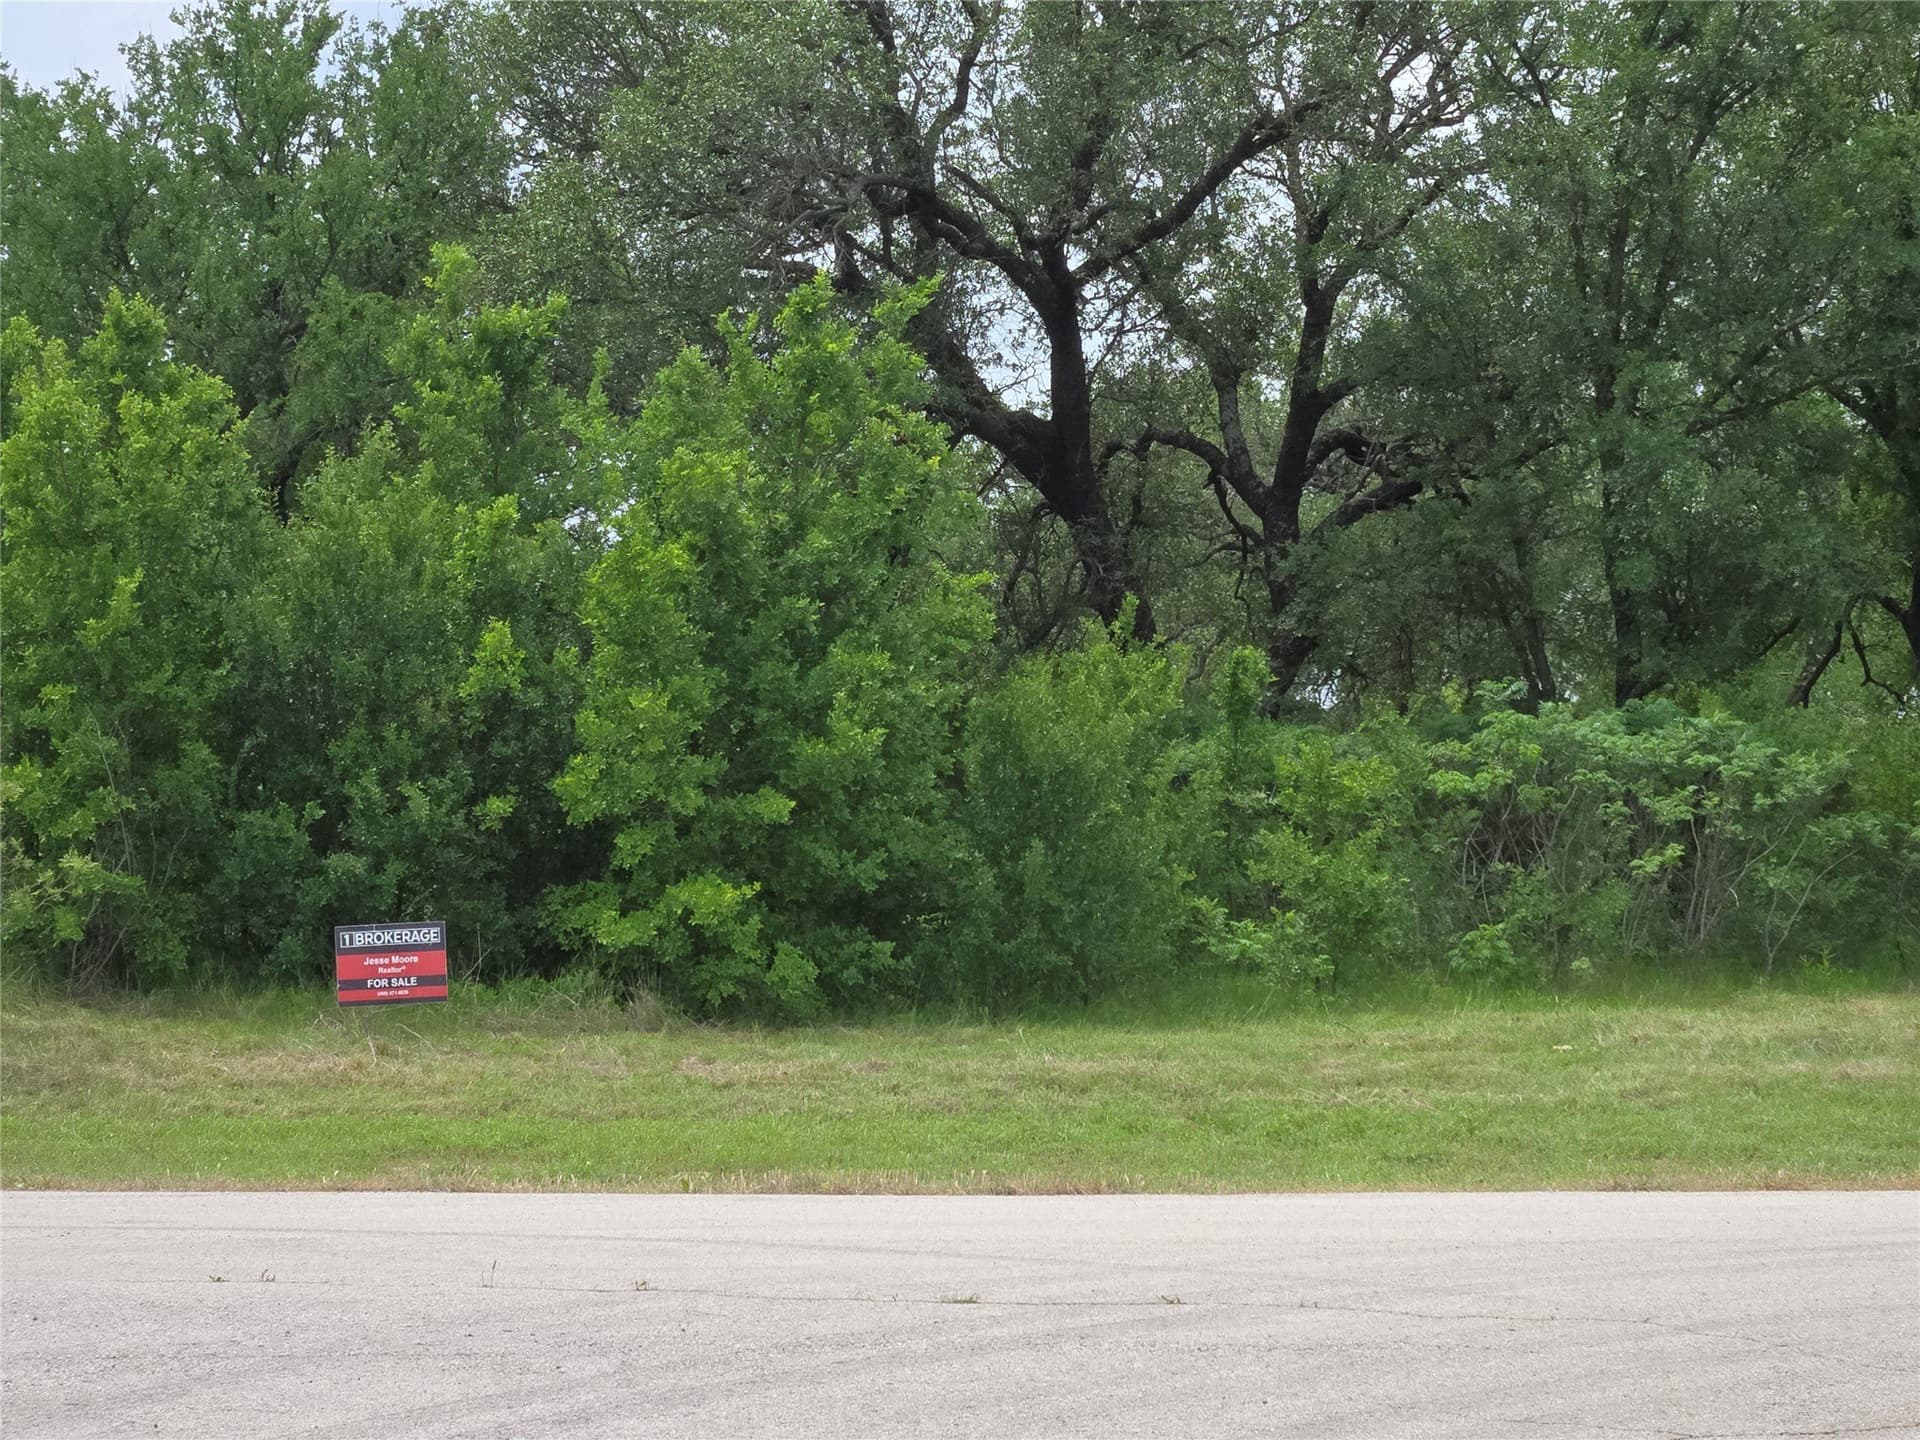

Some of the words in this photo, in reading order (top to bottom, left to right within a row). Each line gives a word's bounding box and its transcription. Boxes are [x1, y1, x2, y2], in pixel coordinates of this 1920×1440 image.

[343, 934, 350, 946] 1
[355, 929, 438, 945] BROKERAGE
[363, 956, 390, 966] Jesse
[391, 955, 419, 964] Moore
[367, 978, 389, 988] FOR
[391, 977, 418, 987] SALE
